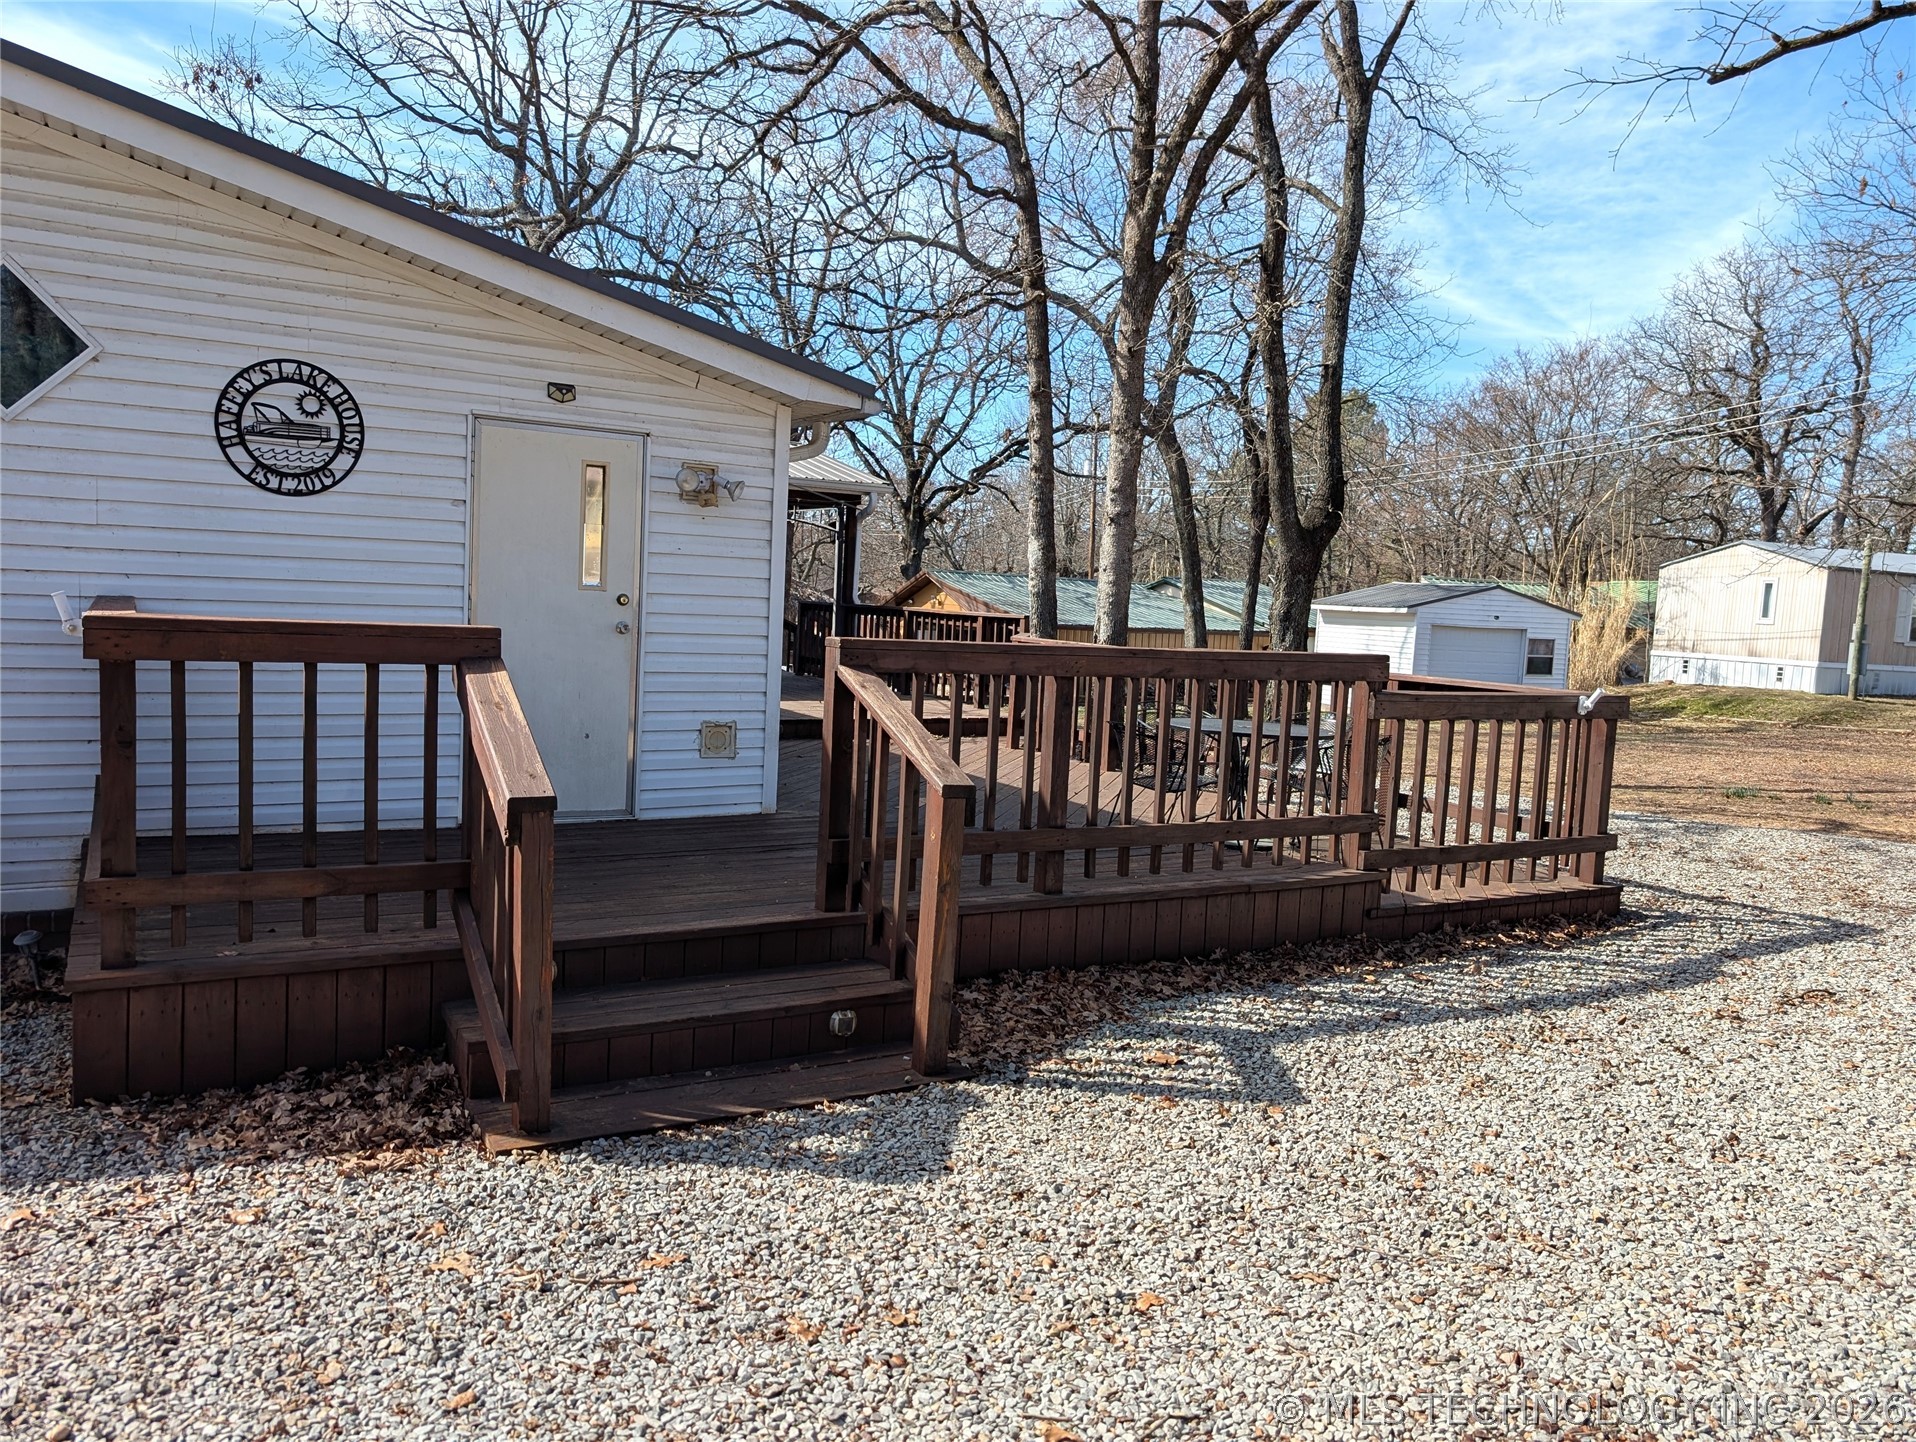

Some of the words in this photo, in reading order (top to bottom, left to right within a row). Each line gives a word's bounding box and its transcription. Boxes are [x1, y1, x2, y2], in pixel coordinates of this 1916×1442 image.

[276, 361, 336, 396] LAKE
[330, 386, 362, 459] HOUSE
[289, 467, 337, 495] 2019
